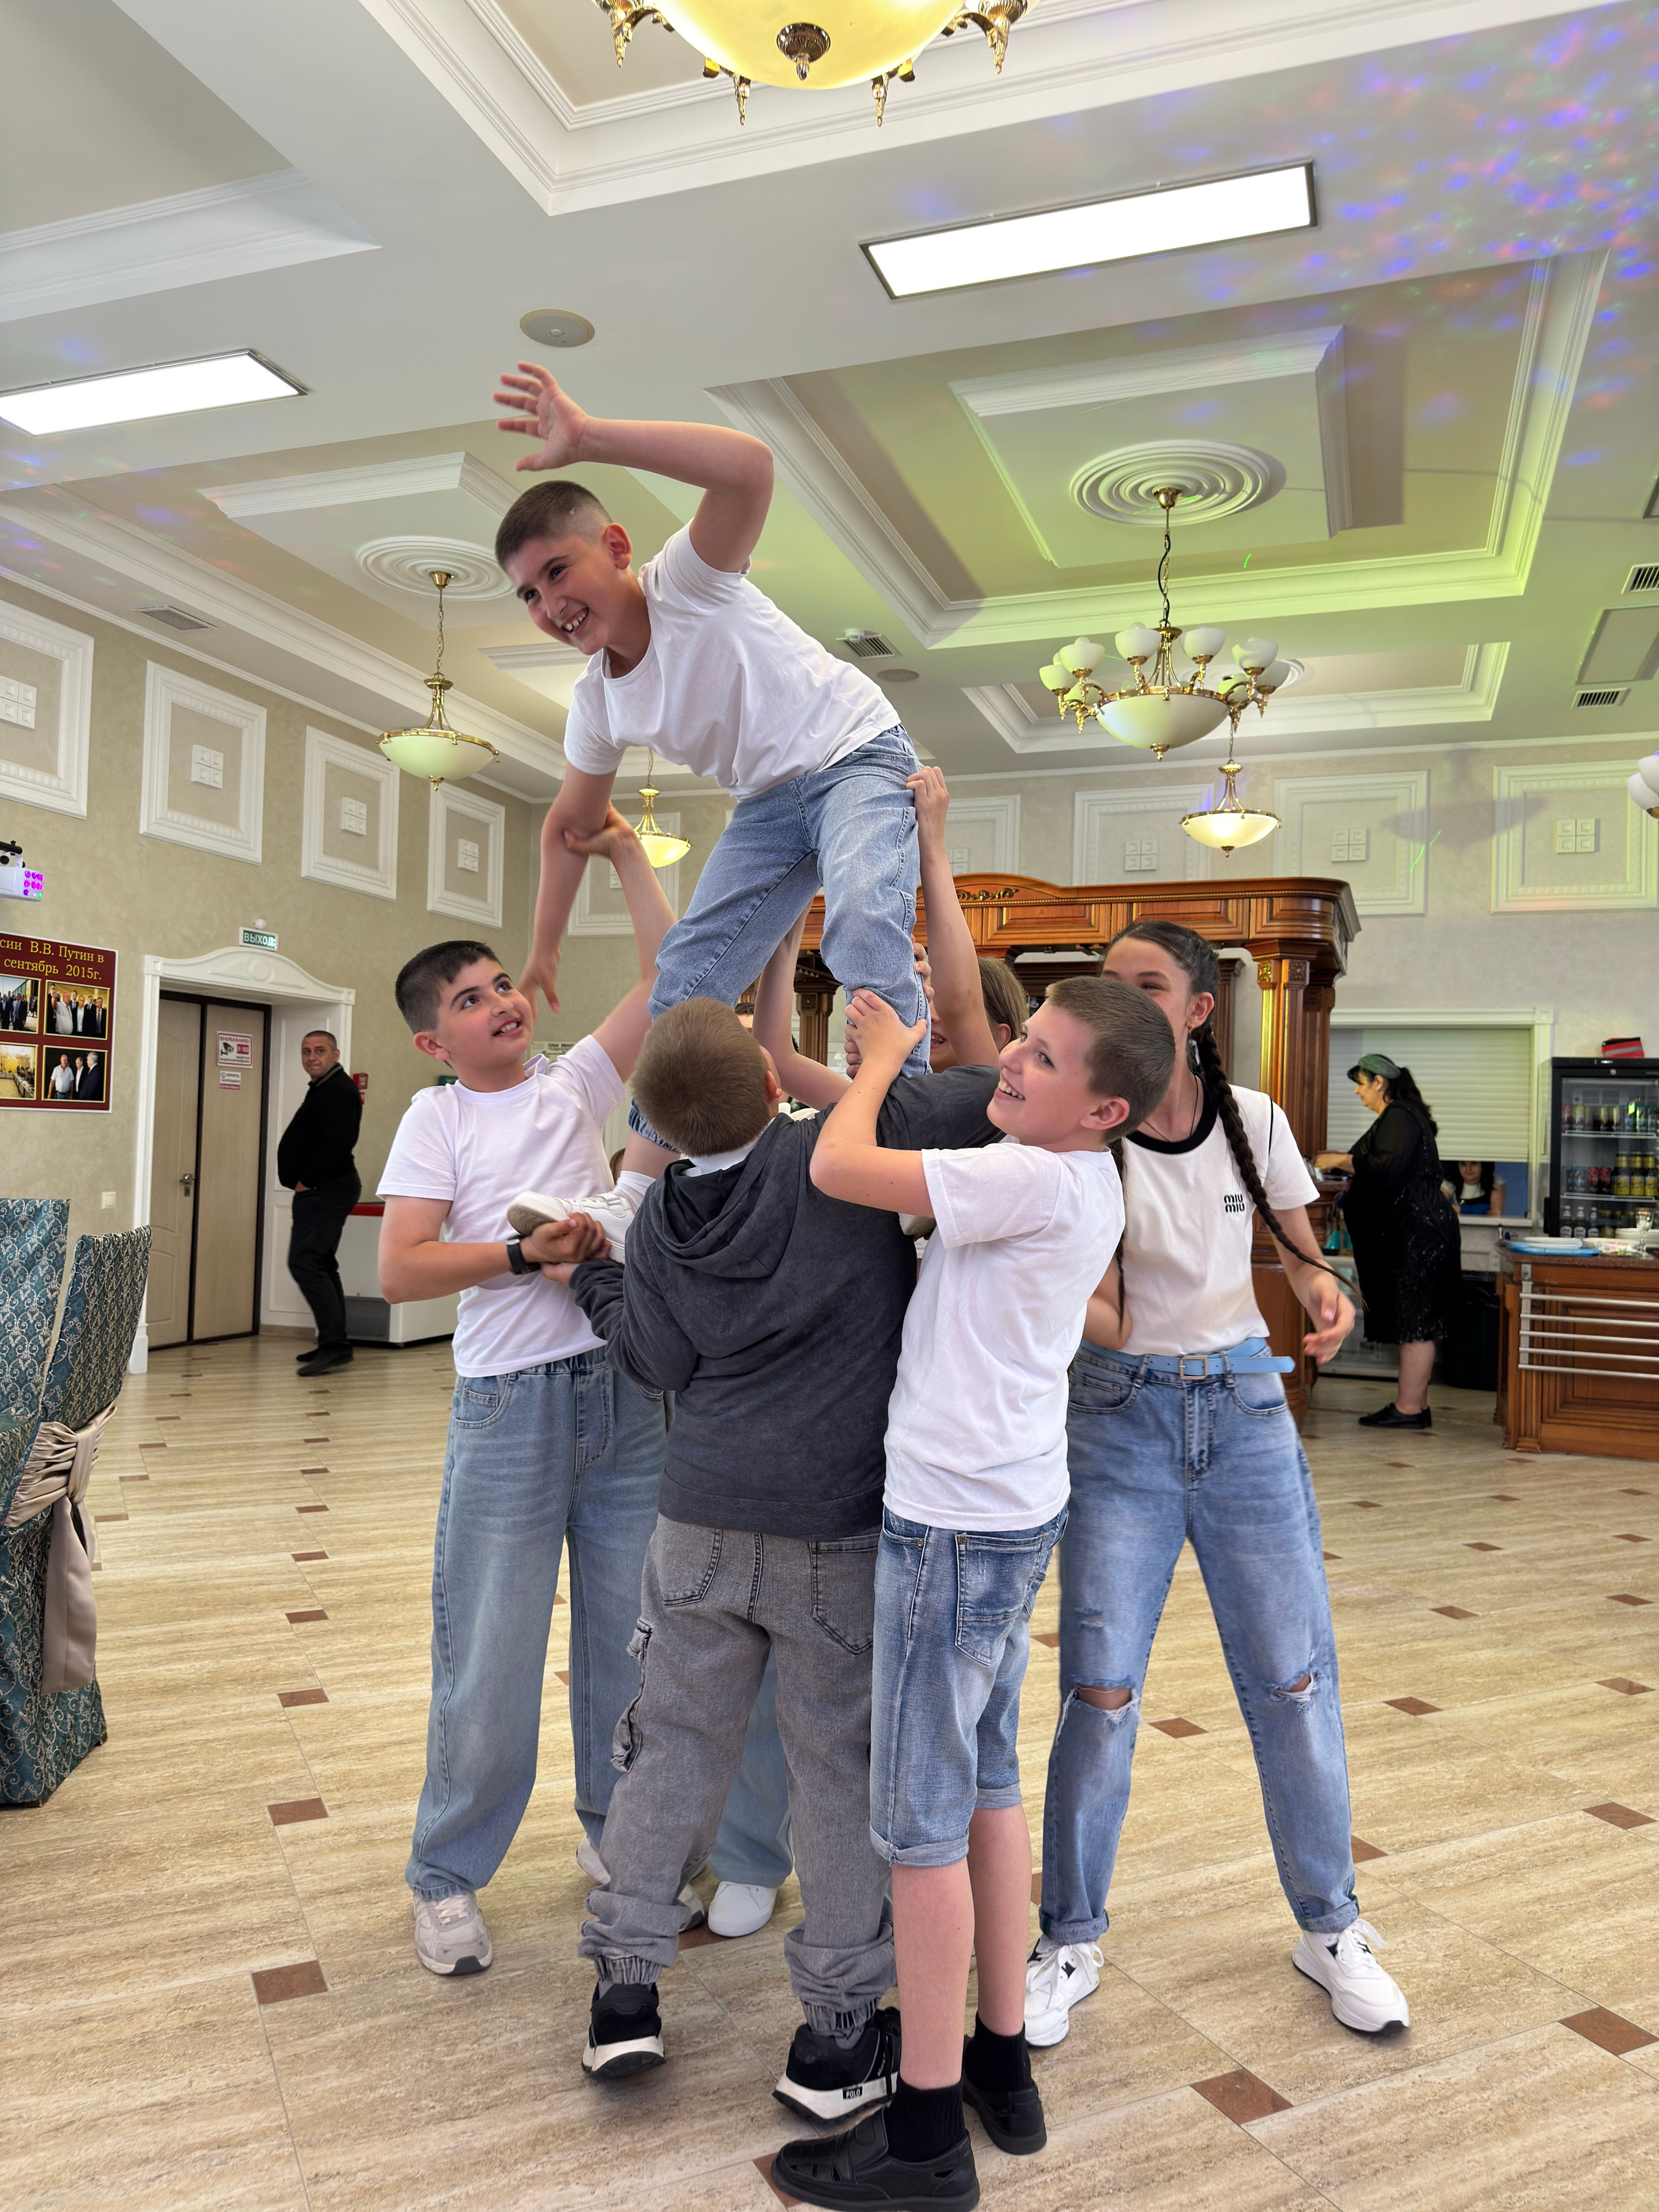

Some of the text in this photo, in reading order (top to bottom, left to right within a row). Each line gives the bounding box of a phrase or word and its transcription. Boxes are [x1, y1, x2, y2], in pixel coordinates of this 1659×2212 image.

[244, 932, 274, 948] ВЫХОД
[0, 939, 104, 963] сии В.В. Путин в
[4, 958, 102, 980] сентябрь 2015г.
[846, 2088, 861, 2099] POLO
